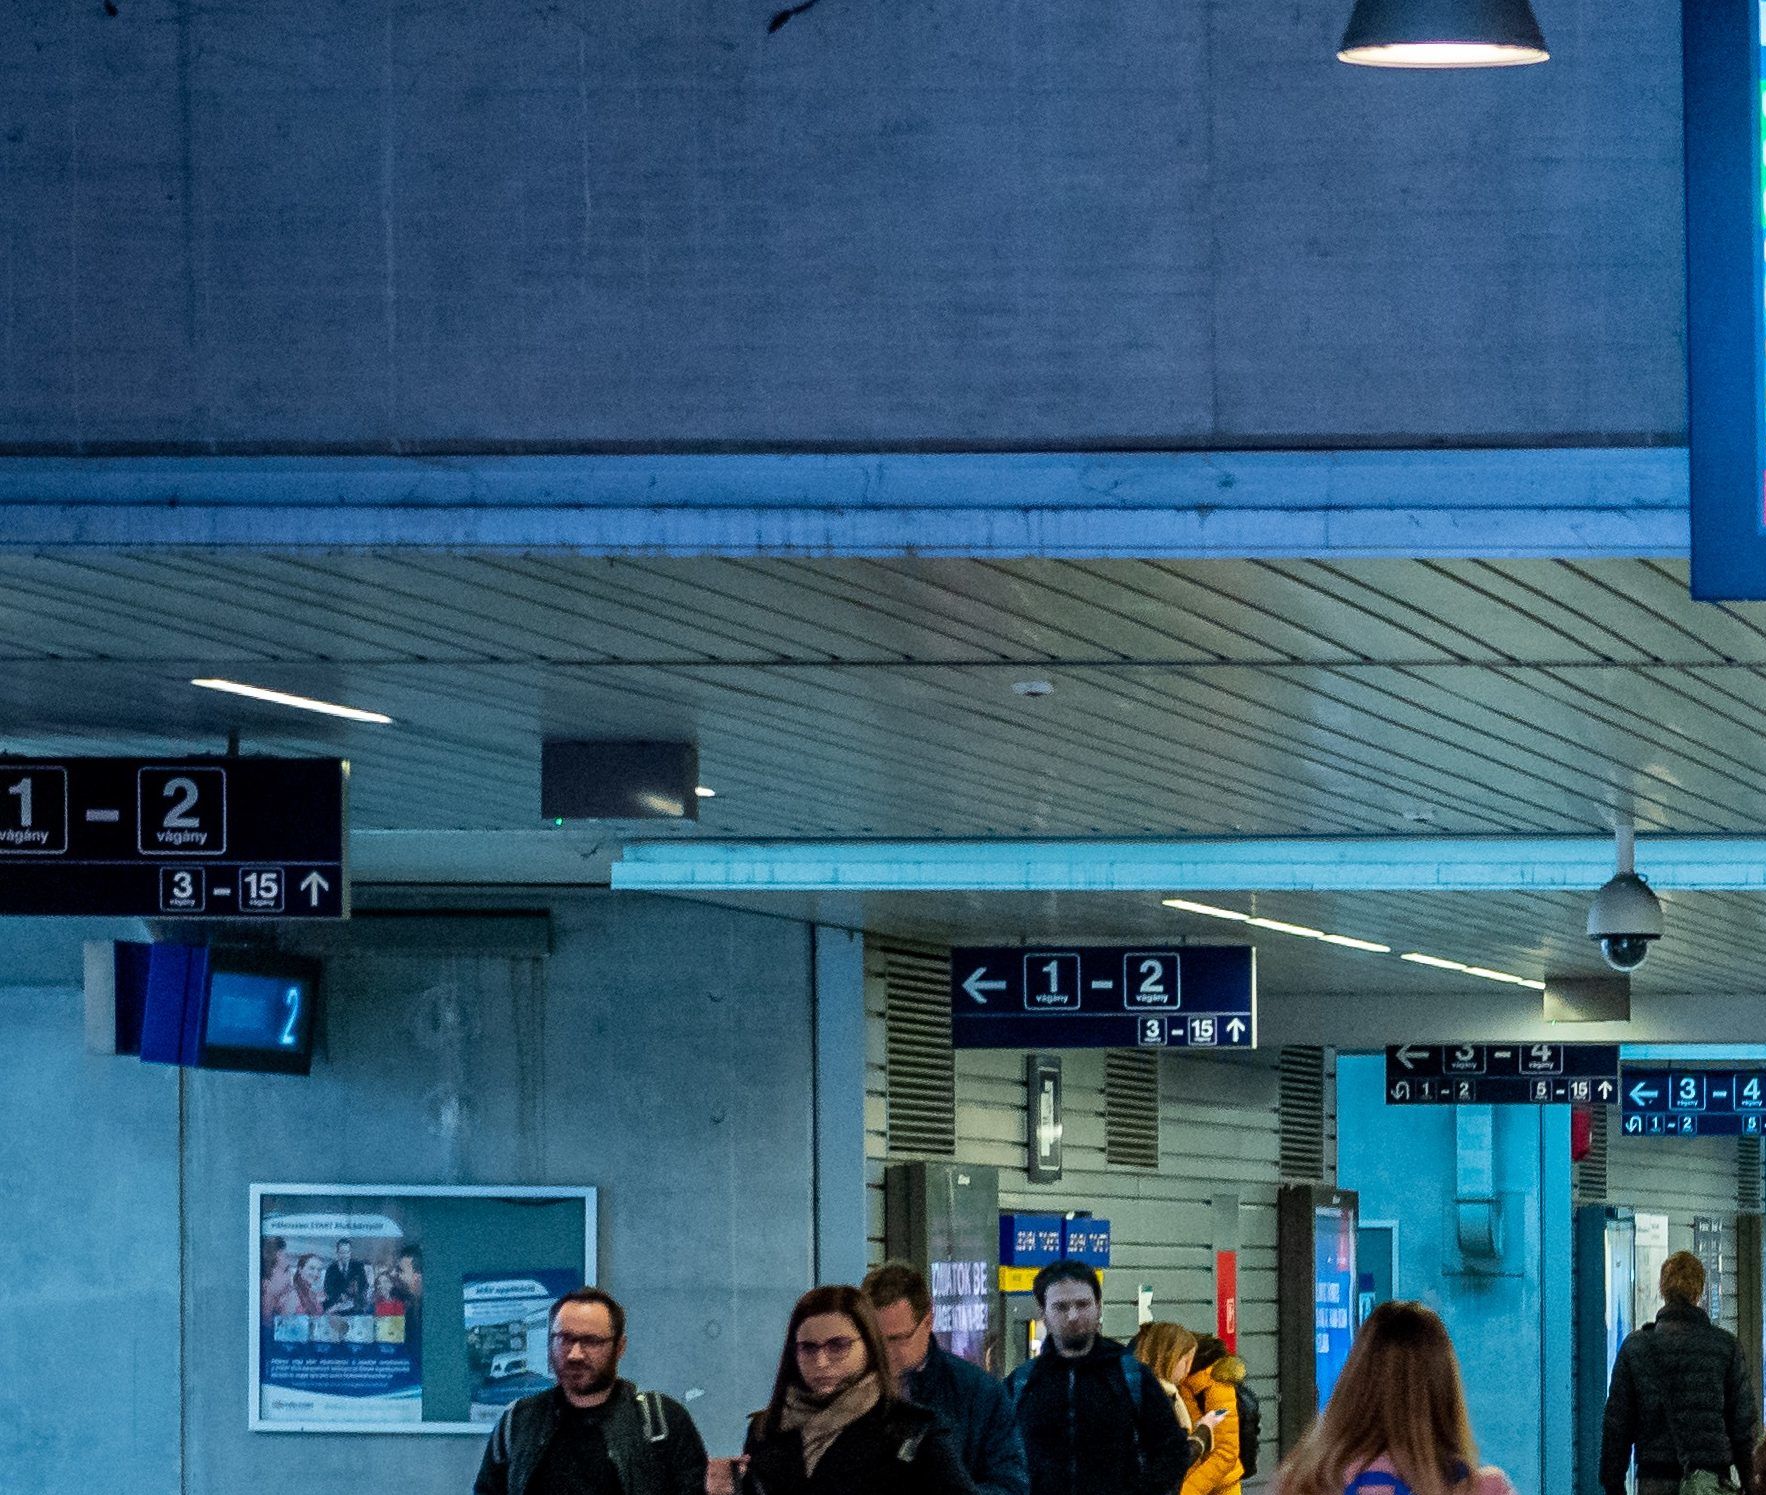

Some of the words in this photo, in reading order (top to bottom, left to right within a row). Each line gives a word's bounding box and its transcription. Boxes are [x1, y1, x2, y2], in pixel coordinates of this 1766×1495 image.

[8, 778, 33, 828] 1
[162, 777, 201, 829] 2
[156, 828, 208, 845] vágány
[173, 871, 193, 899] 3
[244, 871, 278, 899] 15
[1042, 960, 1058, 992] 1
[1139, 959, 1164, 993] 2
[1146, 1019, 1160, 1037] 3
[1191, 1019, 1213, 1037] 15
[1679, 1077, 1696, 1100] 3
[1743, 1077, 1761, 1100] 4
